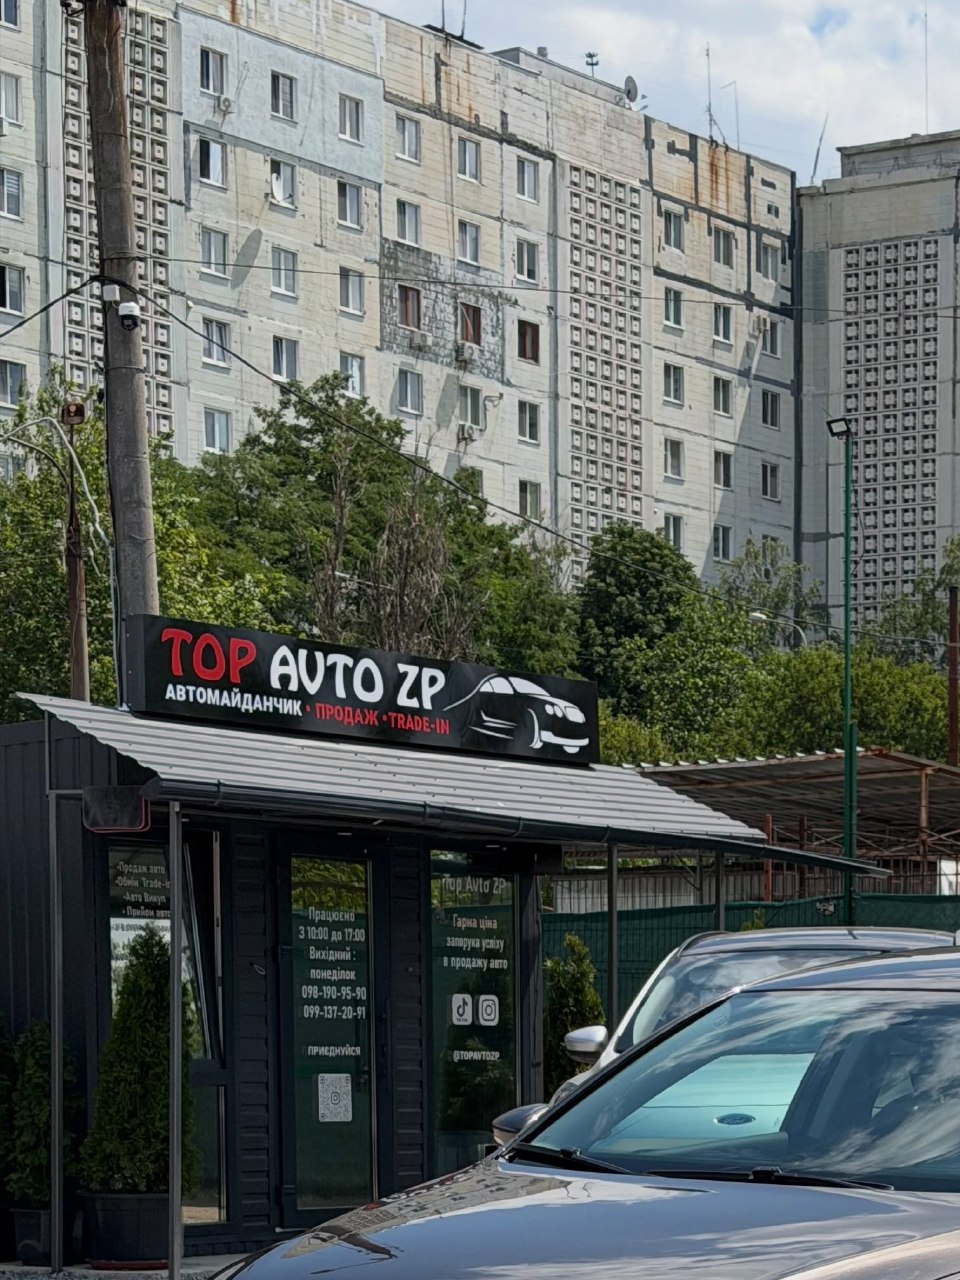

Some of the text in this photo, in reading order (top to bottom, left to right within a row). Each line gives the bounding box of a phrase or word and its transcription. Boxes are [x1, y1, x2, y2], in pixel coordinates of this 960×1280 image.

[160, 627, 446, 711] TOP AVTO ZP
[165, 683, 450, 735] АВТОМАЙДАНЧИК ПРОДАЖ TRADE-IN
[308, 906, 356, 924] Працюємо
[452, 915, 498, 930] Гарна ціна
[307, 926, 328, 940] 10:00
[331, 931, 343, 943] до
[344, 928, 366, 942] 17:00
[309, 946, 351, 962] Вихідний
[450, 957, 488, 972] продажу
[489, 958, 508, 970] авто
[310, 966, 356, 981] понеділок
[301, 985, 367, 1000] 098-190-95-90
[303, 1005, 366, 1019] 099-137-20-91
[307, 1044, 361, 1057] ПРИЄДНУЙСЯ
